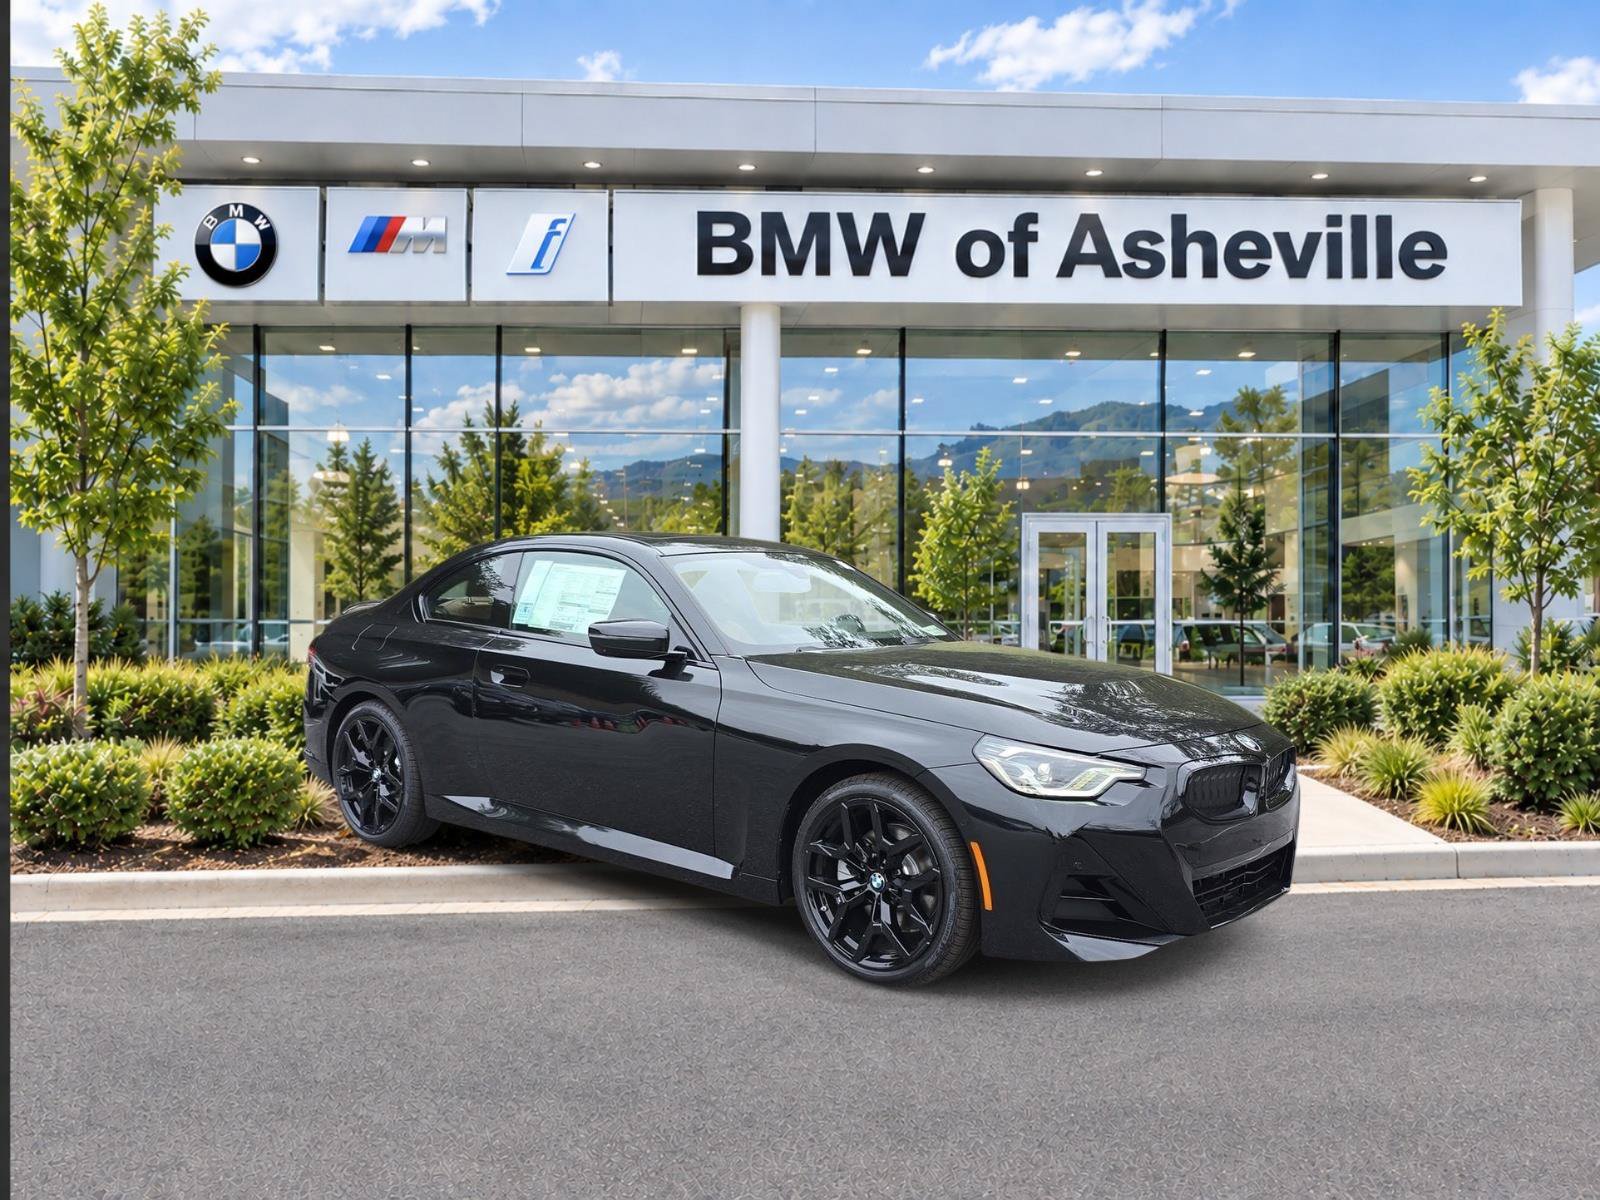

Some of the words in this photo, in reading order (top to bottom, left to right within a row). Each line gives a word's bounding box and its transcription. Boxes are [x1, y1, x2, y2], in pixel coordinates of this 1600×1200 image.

[203, 204, 270, 231] BMW
[696, 210, 926, 277] BMW
[955, 211, 1039, 279] of
[1055, 212, 1448, 281] Asheville
